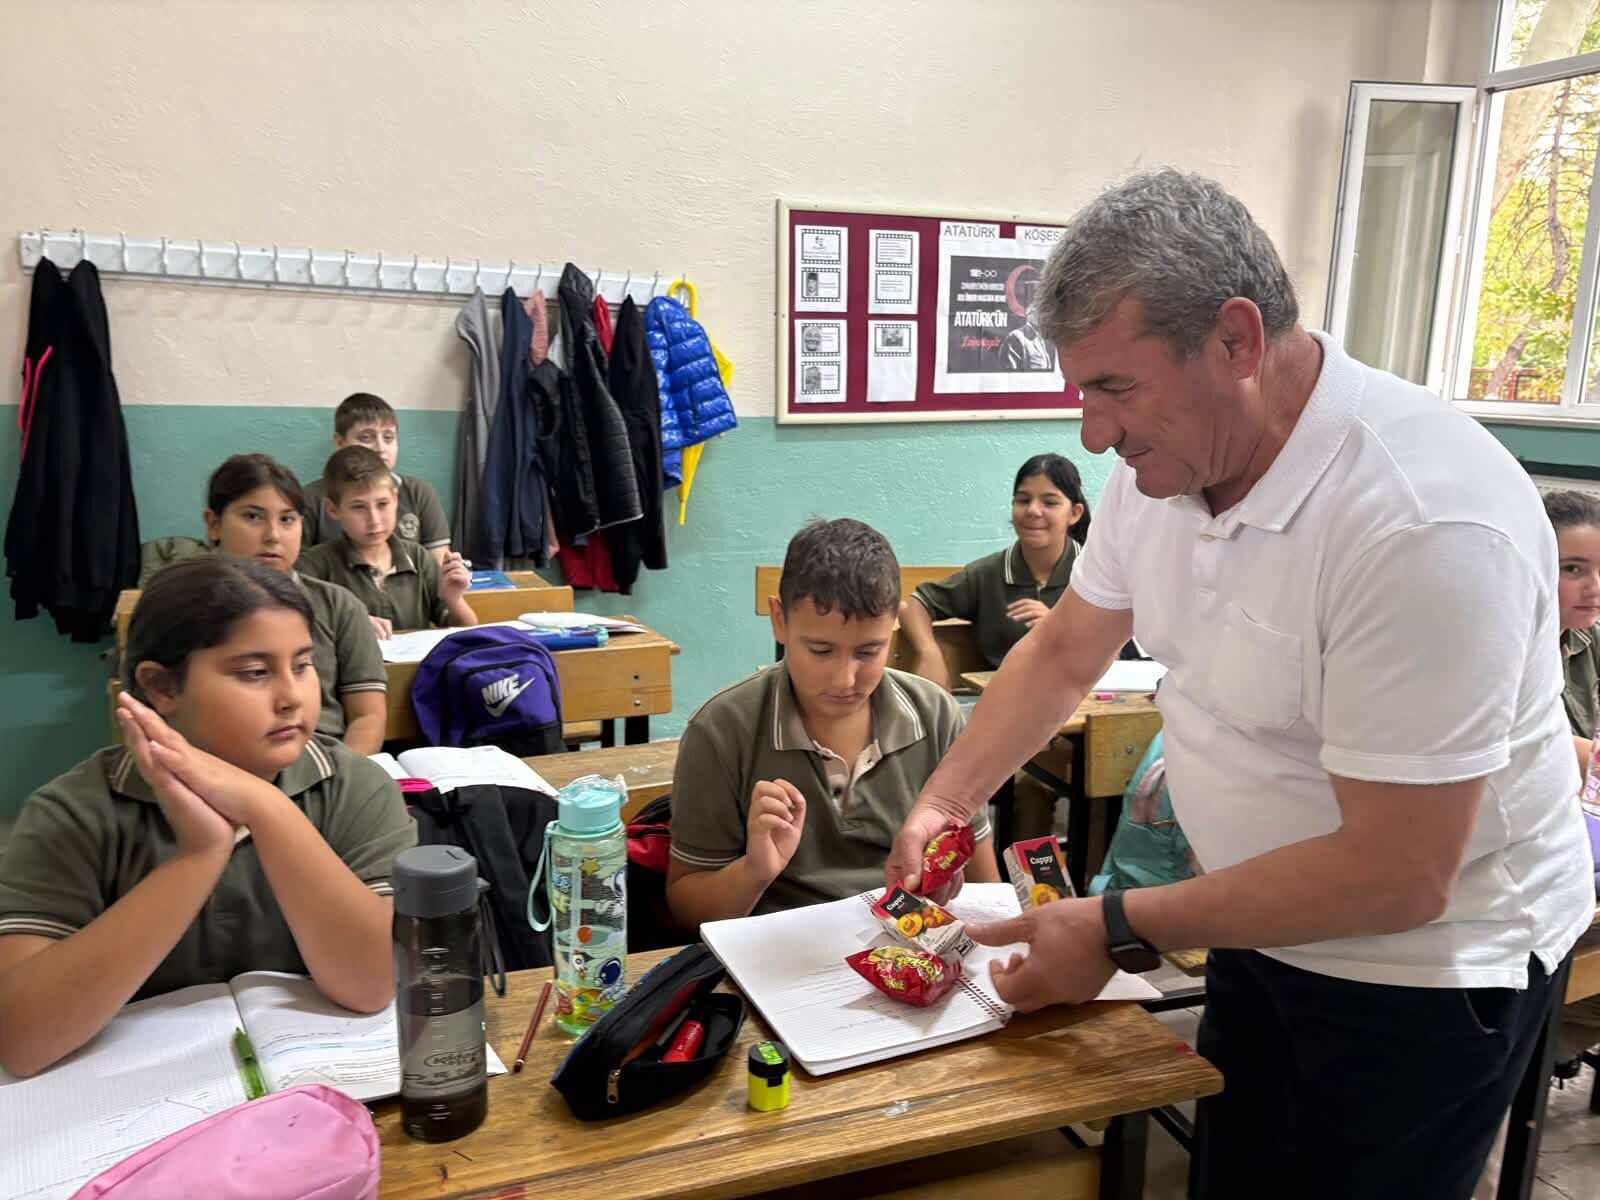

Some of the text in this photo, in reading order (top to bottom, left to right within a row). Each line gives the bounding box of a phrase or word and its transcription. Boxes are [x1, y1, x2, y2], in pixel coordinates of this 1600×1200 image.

[944, 225, 1060, 243] ATATÜRK KÖŞES
[481, 674, 519, 705] NIKE
[1030, 855, 1053, 865] Cappy
[886, 892, 905, 911] Cappy
